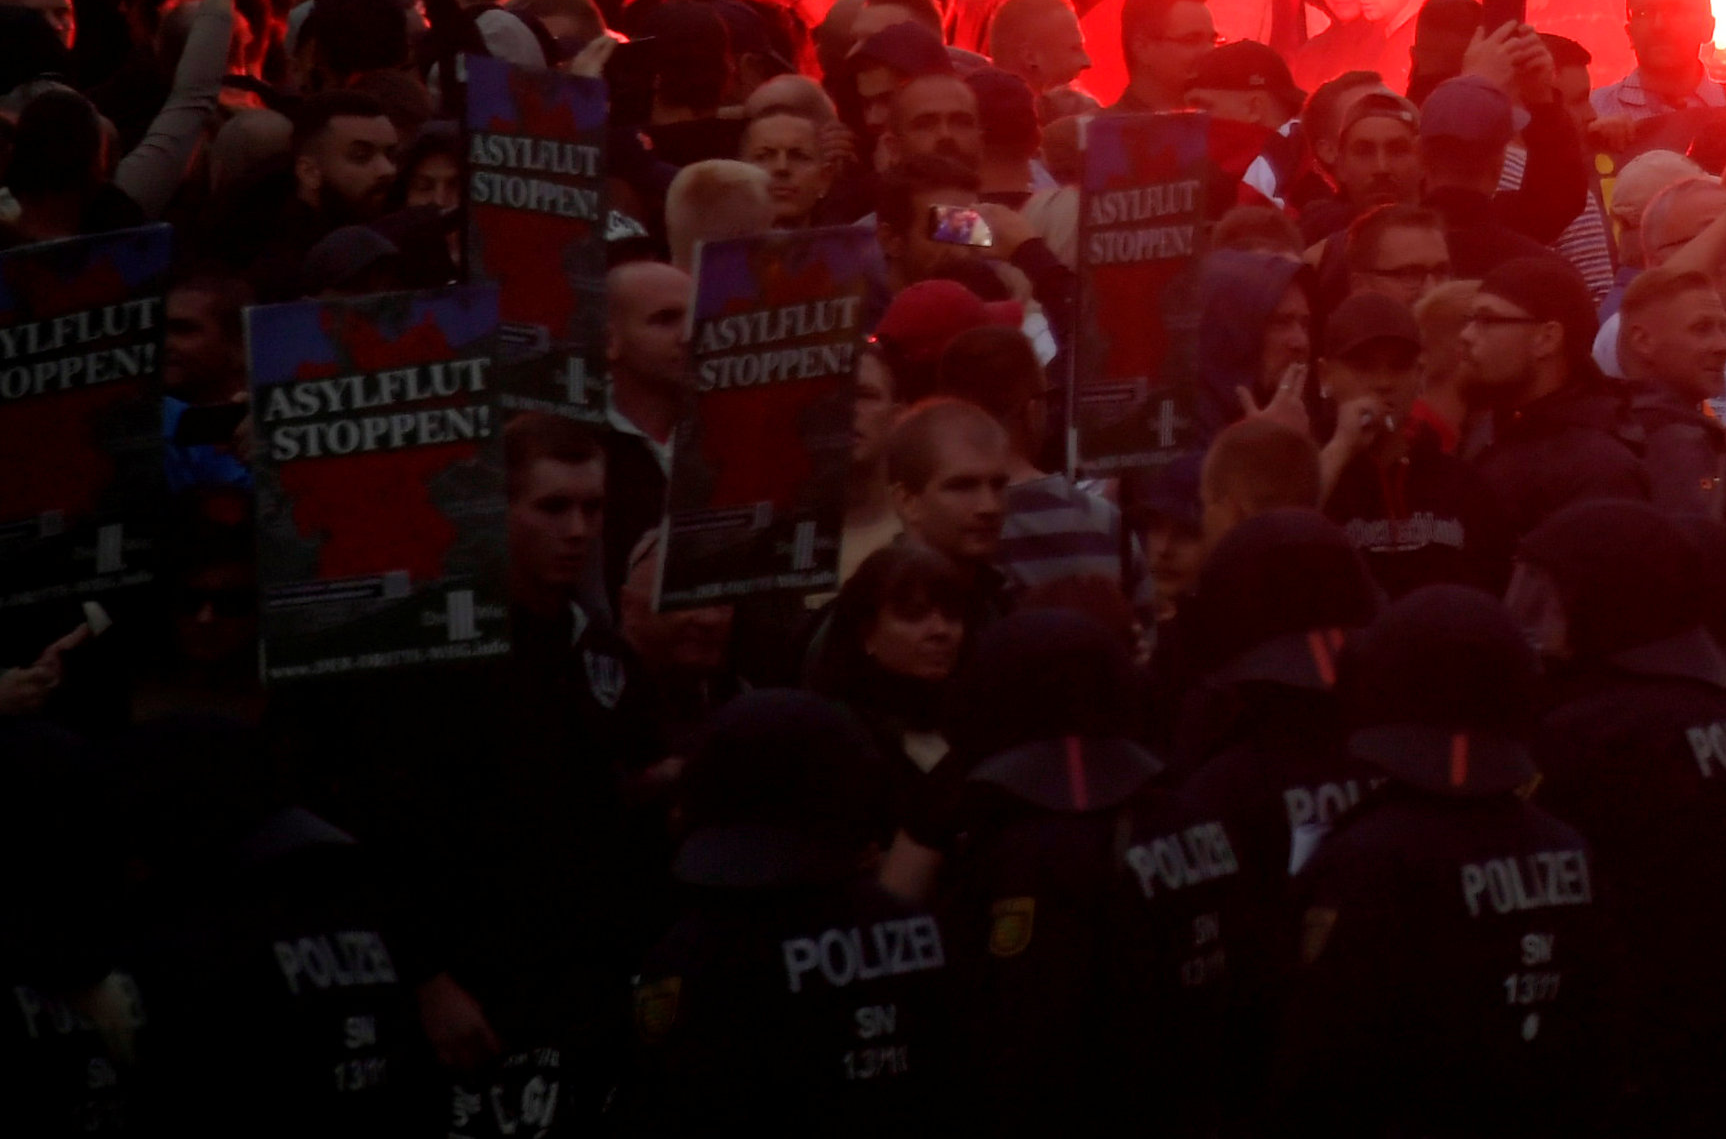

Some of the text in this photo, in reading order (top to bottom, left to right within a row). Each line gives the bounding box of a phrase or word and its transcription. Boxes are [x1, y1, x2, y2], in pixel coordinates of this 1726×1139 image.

[468, 133, 601, 178] ASYLFLUT
[469, 171, 600, 221] STOPPEN!
[1086, 179, 1200, 228] ASYLFLUT
[1087, 224, 1194, 266] STOPPEN!
[694, 295, 861, 356] ASYLFLUT
[262, 356, 491, 422] ASYLFLUT
[697, 341, 855, 393] STOPPEN!
[270, 404, 491, 462] STOPPEN!
[1458, 848, 1593, 921] POLIZEI
[780, 914, 947, 995] POLIZEI
[1518, 931, 1557, 967] SN
[852, 1002, 897, 1040] SN
